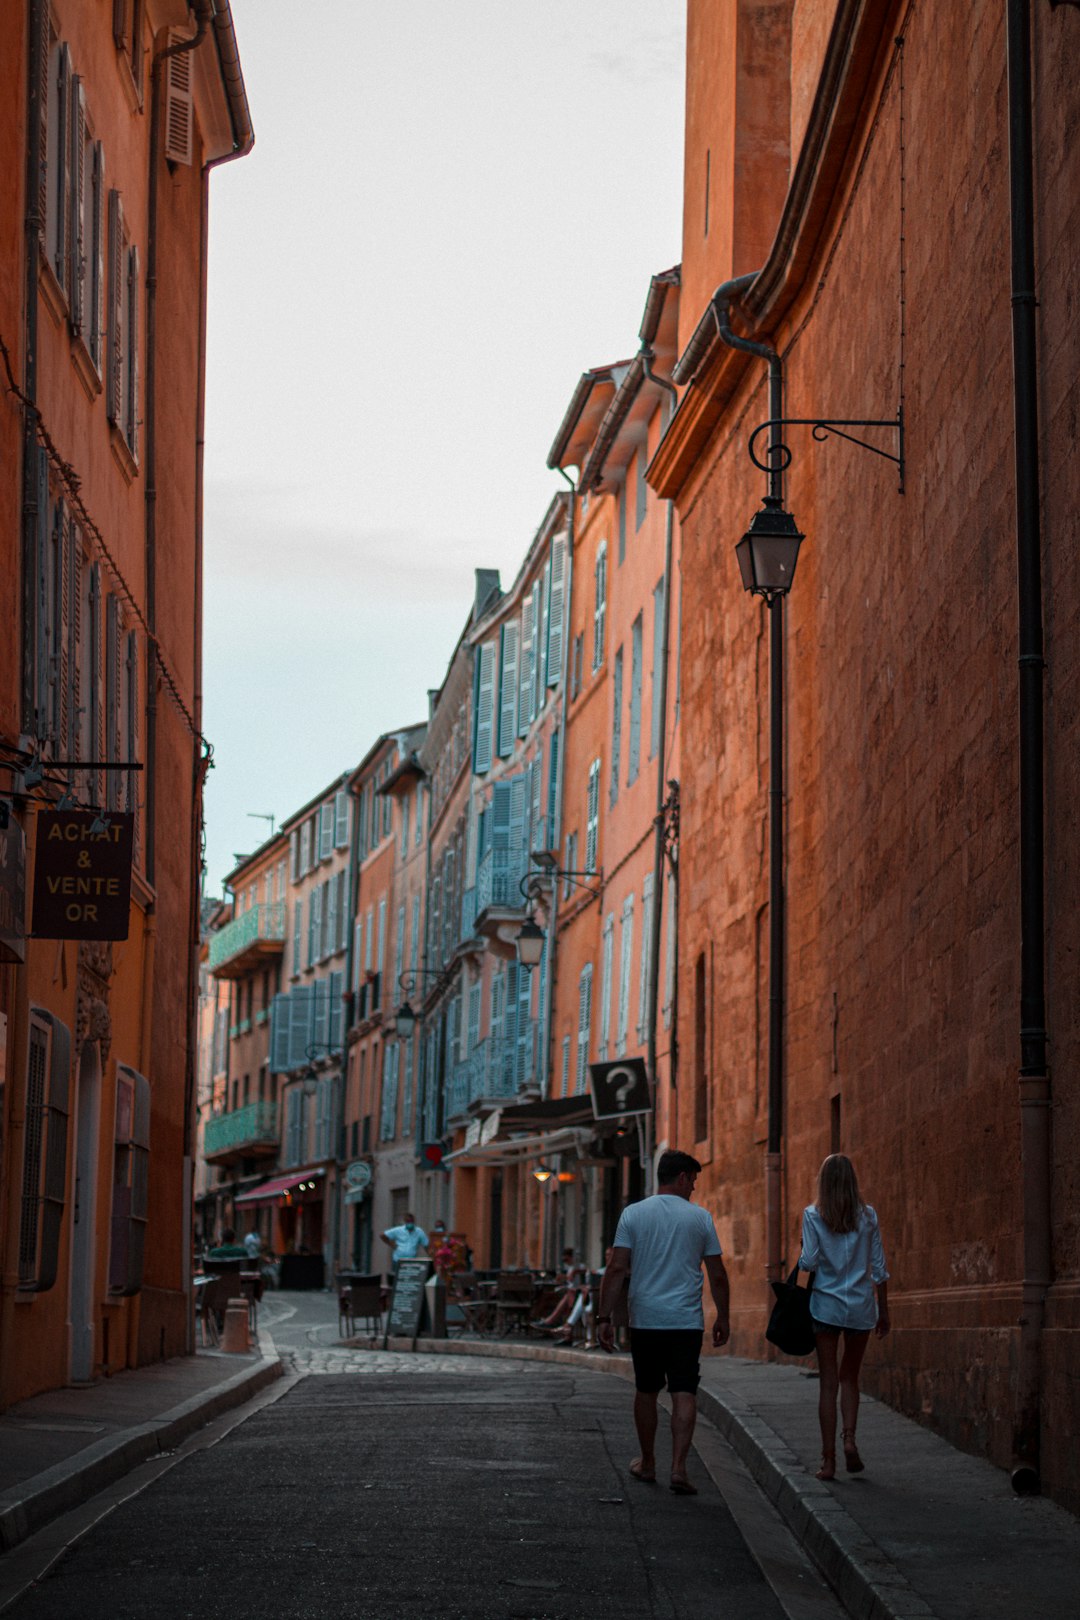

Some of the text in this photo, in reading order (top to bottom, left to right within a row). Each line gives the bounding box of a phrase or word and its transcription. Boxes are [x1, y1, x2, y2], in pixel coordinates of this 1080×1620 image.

[77, 850, 92, 868] &
[46, 876, 119, 896] VENTE
[65, 903, 98, 922] OR
[606, 1066, 637, 1109] ?
